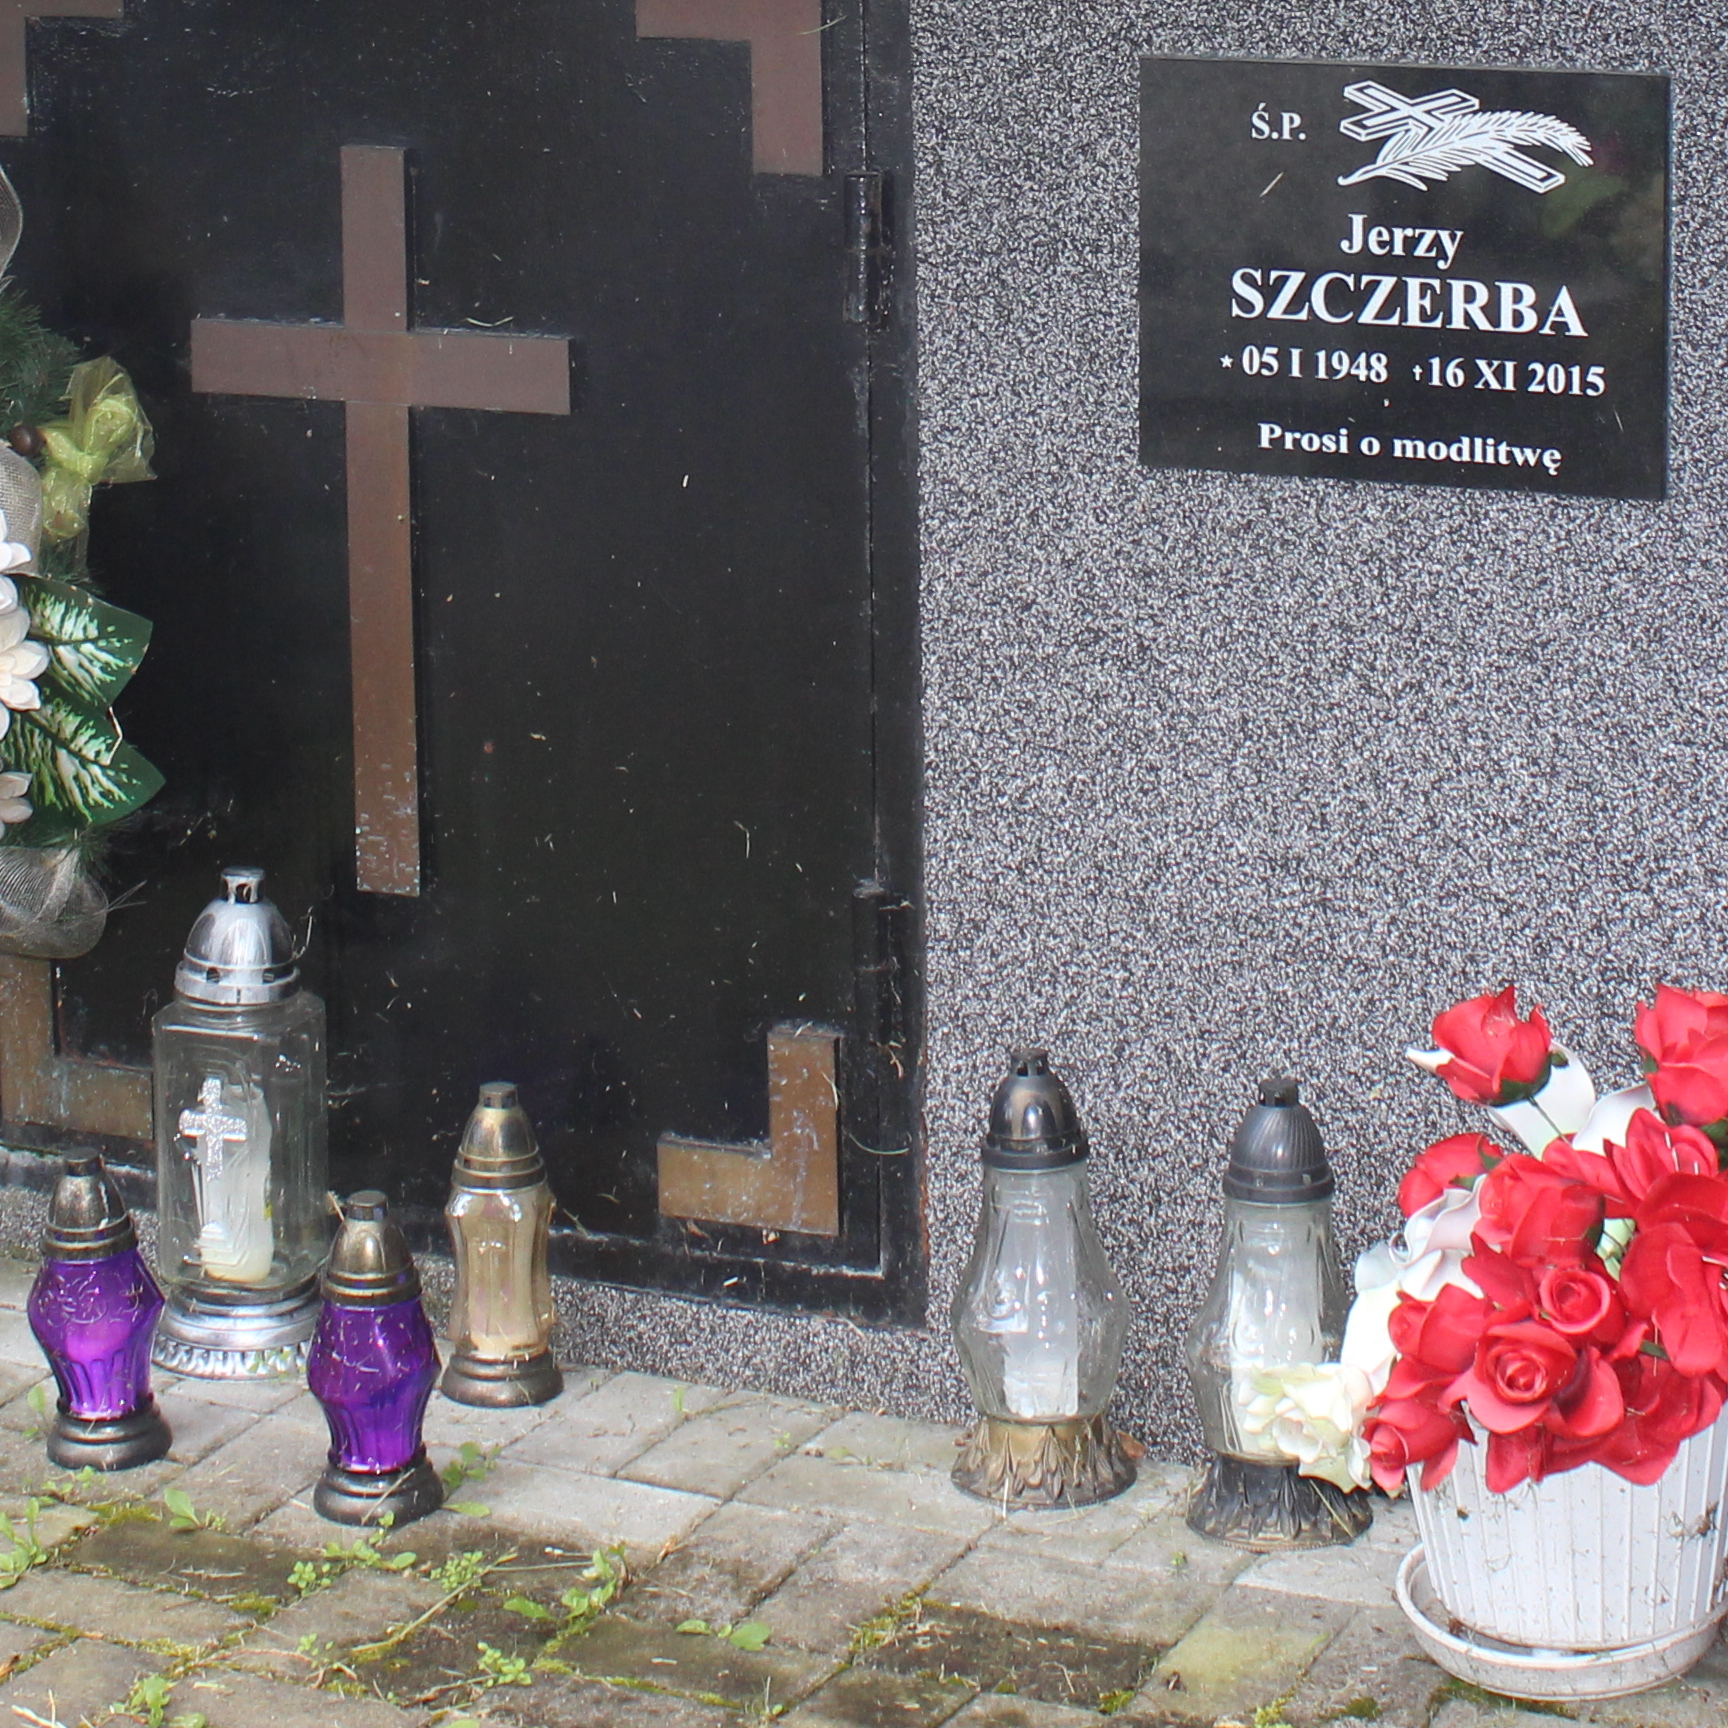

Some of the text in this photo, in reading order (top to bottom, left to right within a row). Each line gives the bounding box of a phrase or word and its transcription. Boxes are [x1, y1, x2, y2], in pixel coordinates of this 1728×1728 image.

[1251, 102, 1306, 140] Ś.P.
[1340, 213, 1464, 270] Jerzy
[1231, 268, 1589, 337] SZCZERBA
[1242, 345, 1279, 376] 05
[1290, 348, 1303, 378] I
[1315, 349, 1388, 383] 1948
[1474, 359, 1517, 391] XI
[1527, 362, 1605, 397] 2015
[1257, 423, 1562, 476] Prosi o modlitwę
